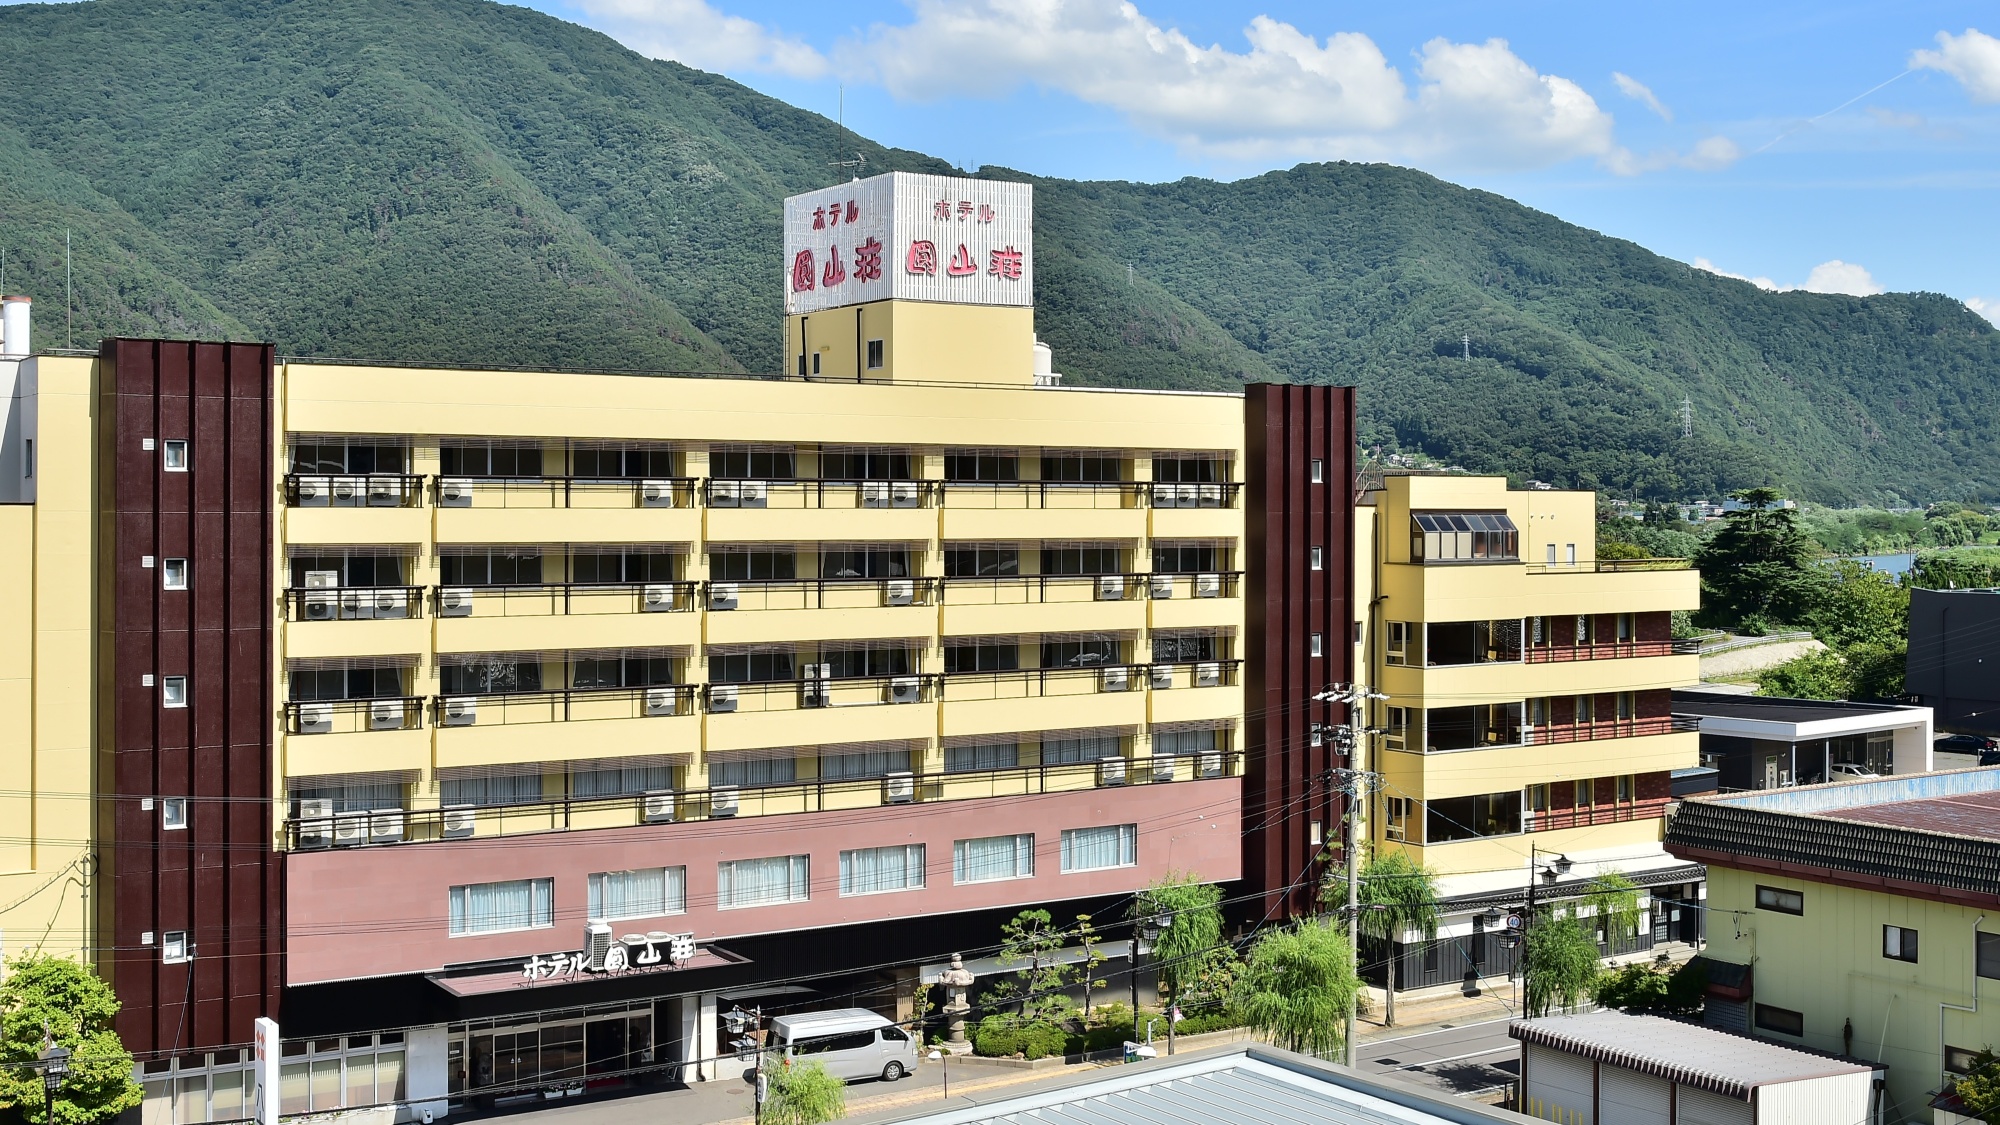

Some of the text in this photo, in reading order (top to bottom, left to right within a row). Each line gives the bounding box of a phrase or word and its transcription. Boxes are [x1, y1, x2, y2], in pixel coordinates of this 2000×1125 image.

[813, 200, 859, 230] ホテル
[934, 199, 995, 223] ホテル
